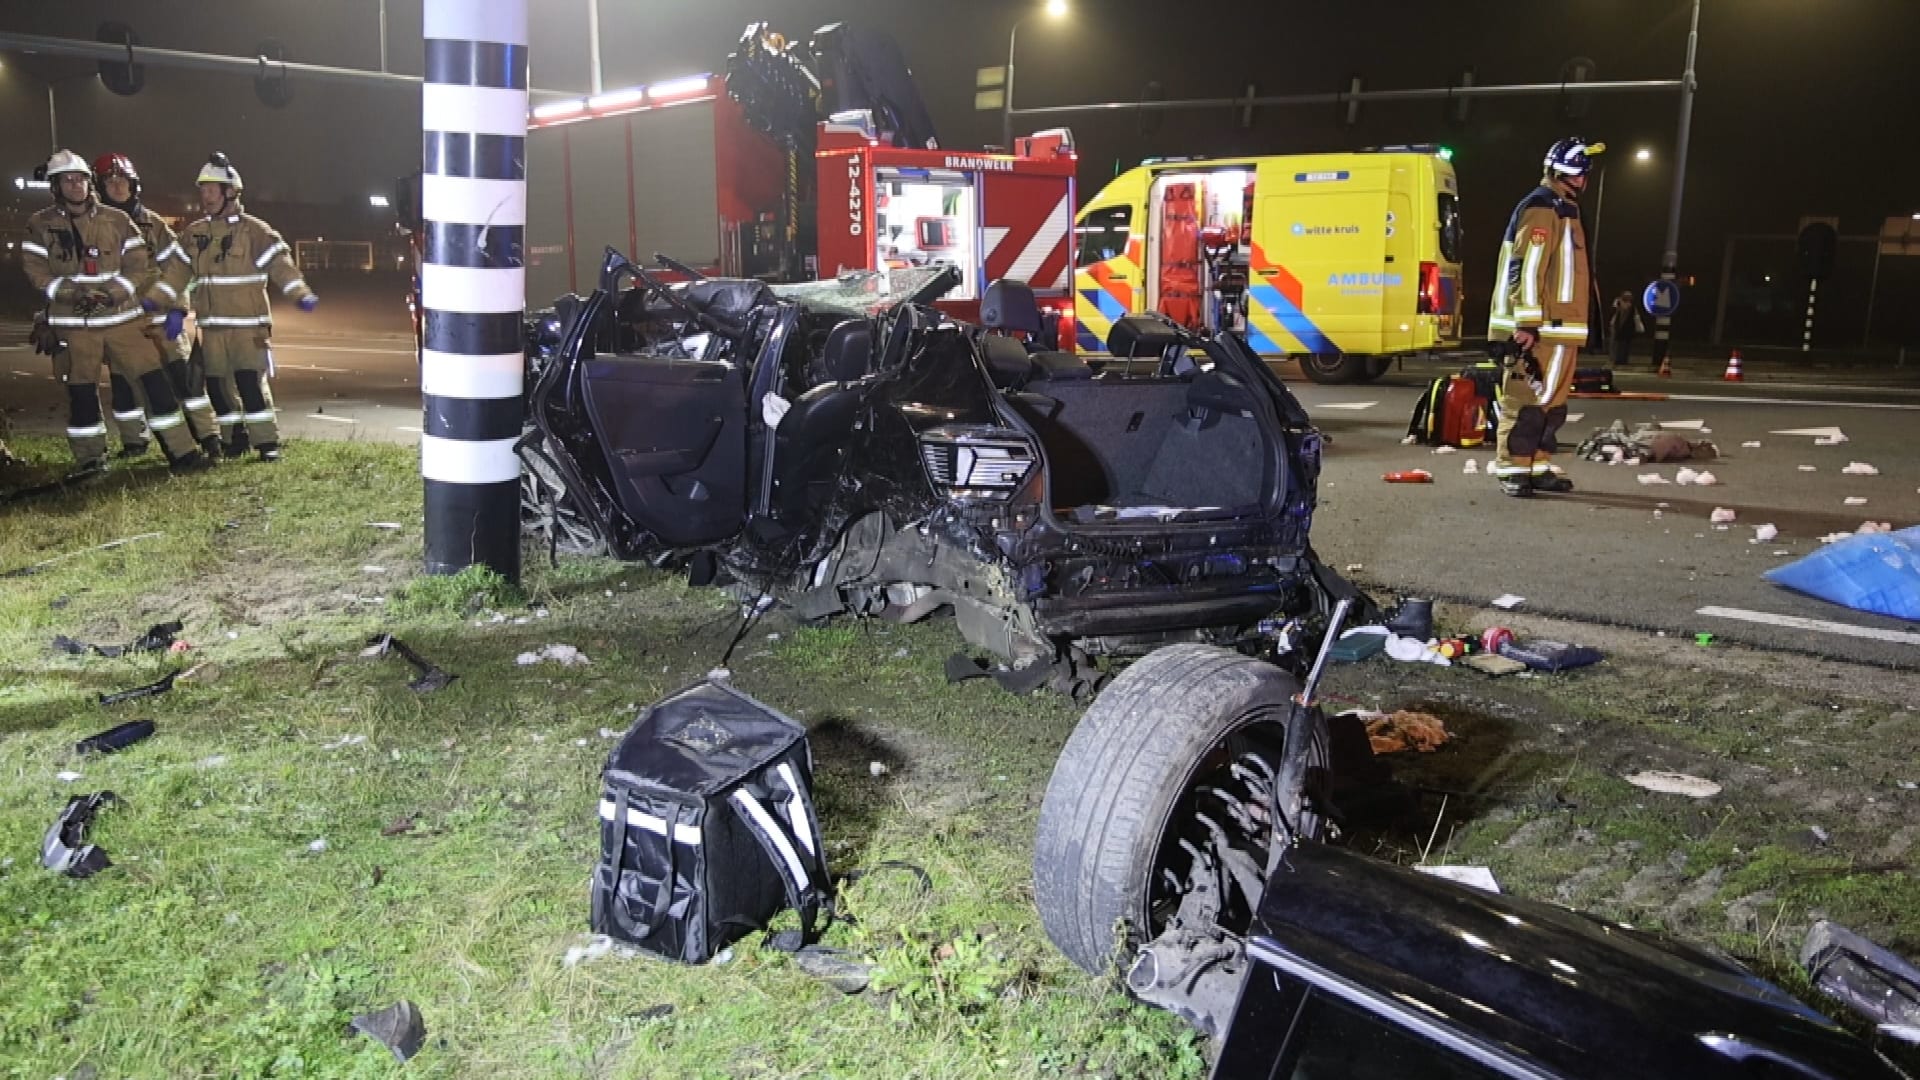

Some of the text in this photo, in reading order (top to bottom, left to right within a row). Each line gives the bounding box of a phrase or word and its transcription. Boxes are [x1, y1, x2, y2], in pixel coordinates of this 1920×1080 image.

[945, 156, 1014, 171] BRANDWEER
[848, 154, 862, 236] 12-4270
[1305, 224, 1360, 235] witte kruis
